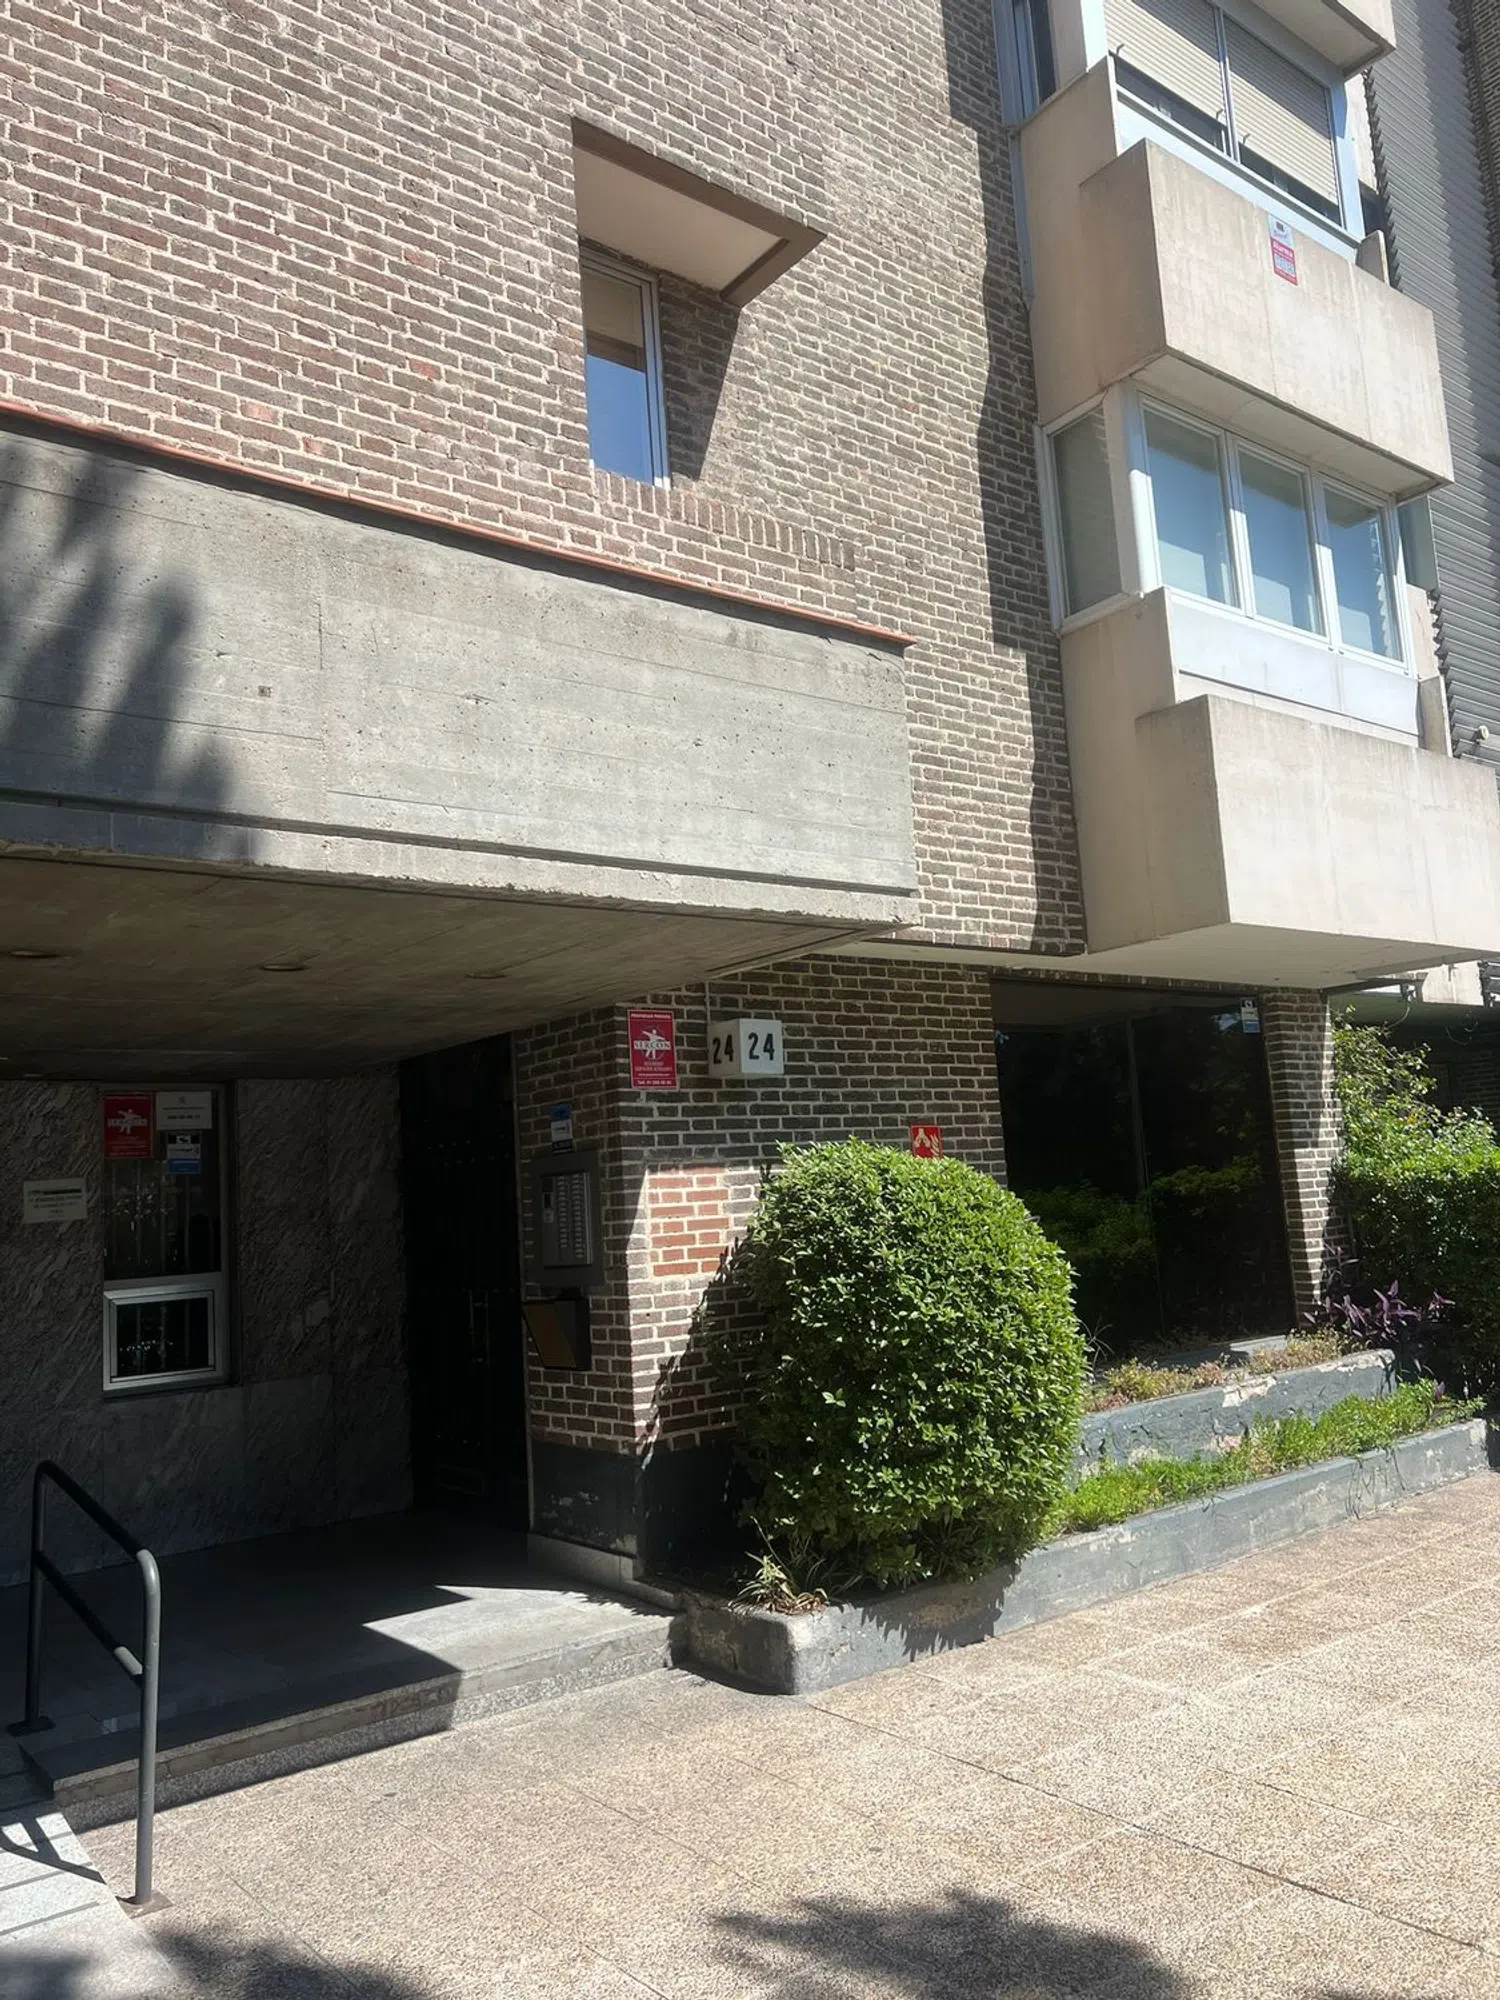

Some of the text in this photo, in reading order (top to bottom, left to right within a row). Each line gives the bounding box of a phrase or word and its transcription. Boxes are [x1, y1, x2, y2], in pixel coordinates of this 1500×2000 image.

[634, 1040, 671, 1050] SERCON
[712, 1034, 734, 1064] 24
[748, 1032, 775, 1061] 24
